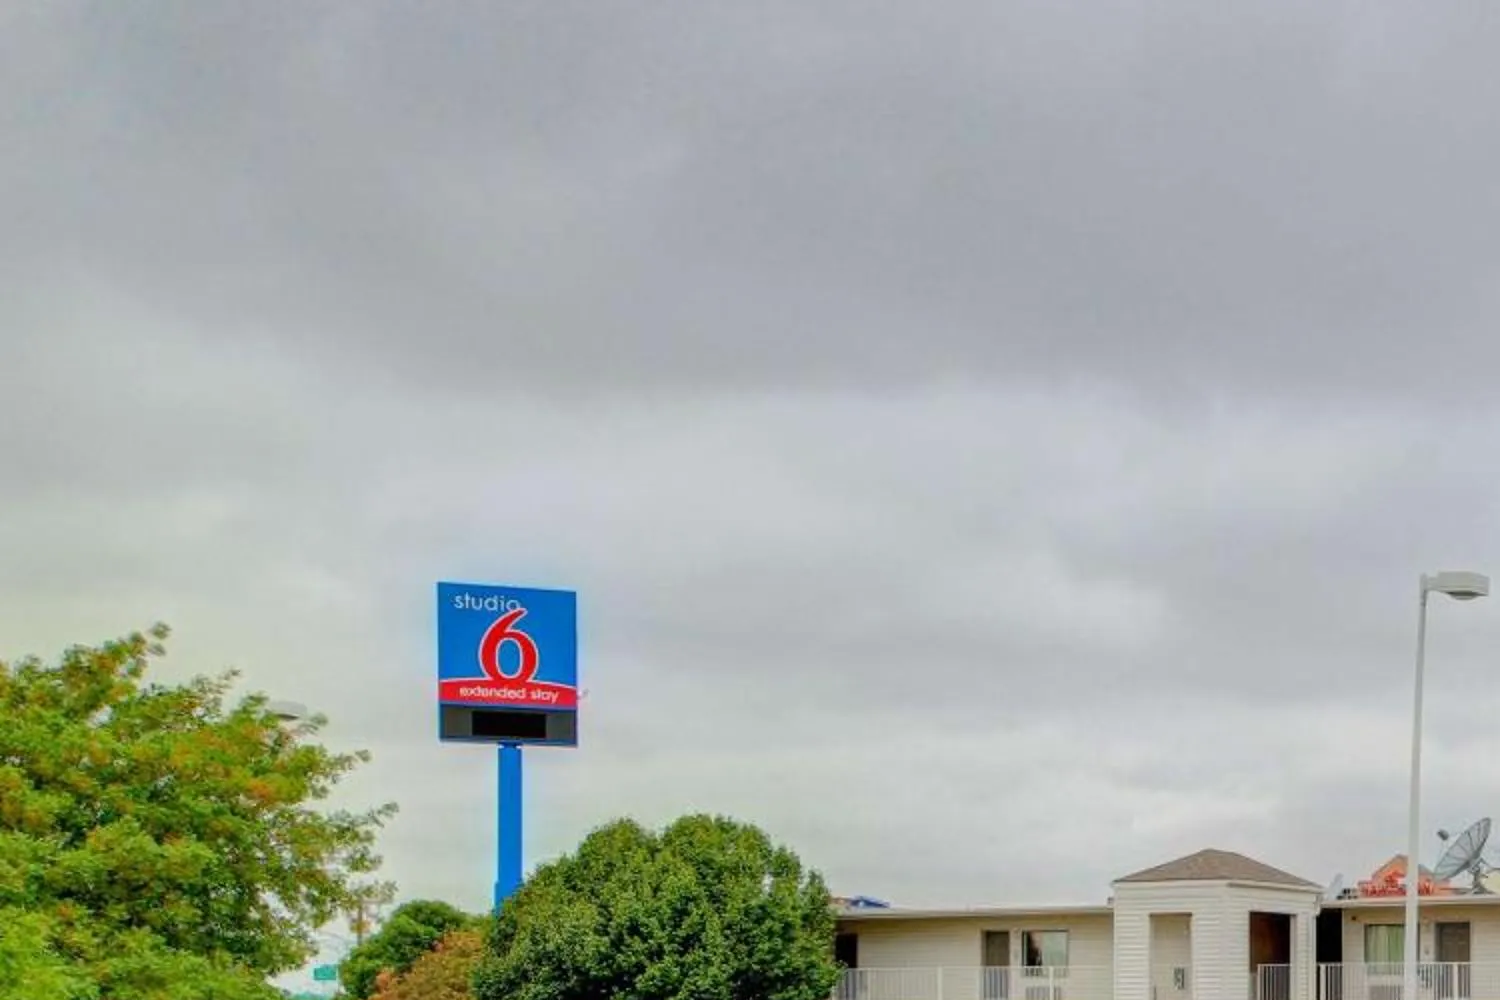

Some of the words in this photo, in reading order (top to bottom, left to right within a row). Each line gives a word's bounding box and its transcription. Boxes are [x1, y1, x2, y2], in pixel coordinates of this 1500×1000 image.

[453, 592, 520, 612] studio
[478, 607, 539, 683] 6
[459, 685, 527, 700] extended
[530, 689, 560, 704] stay
